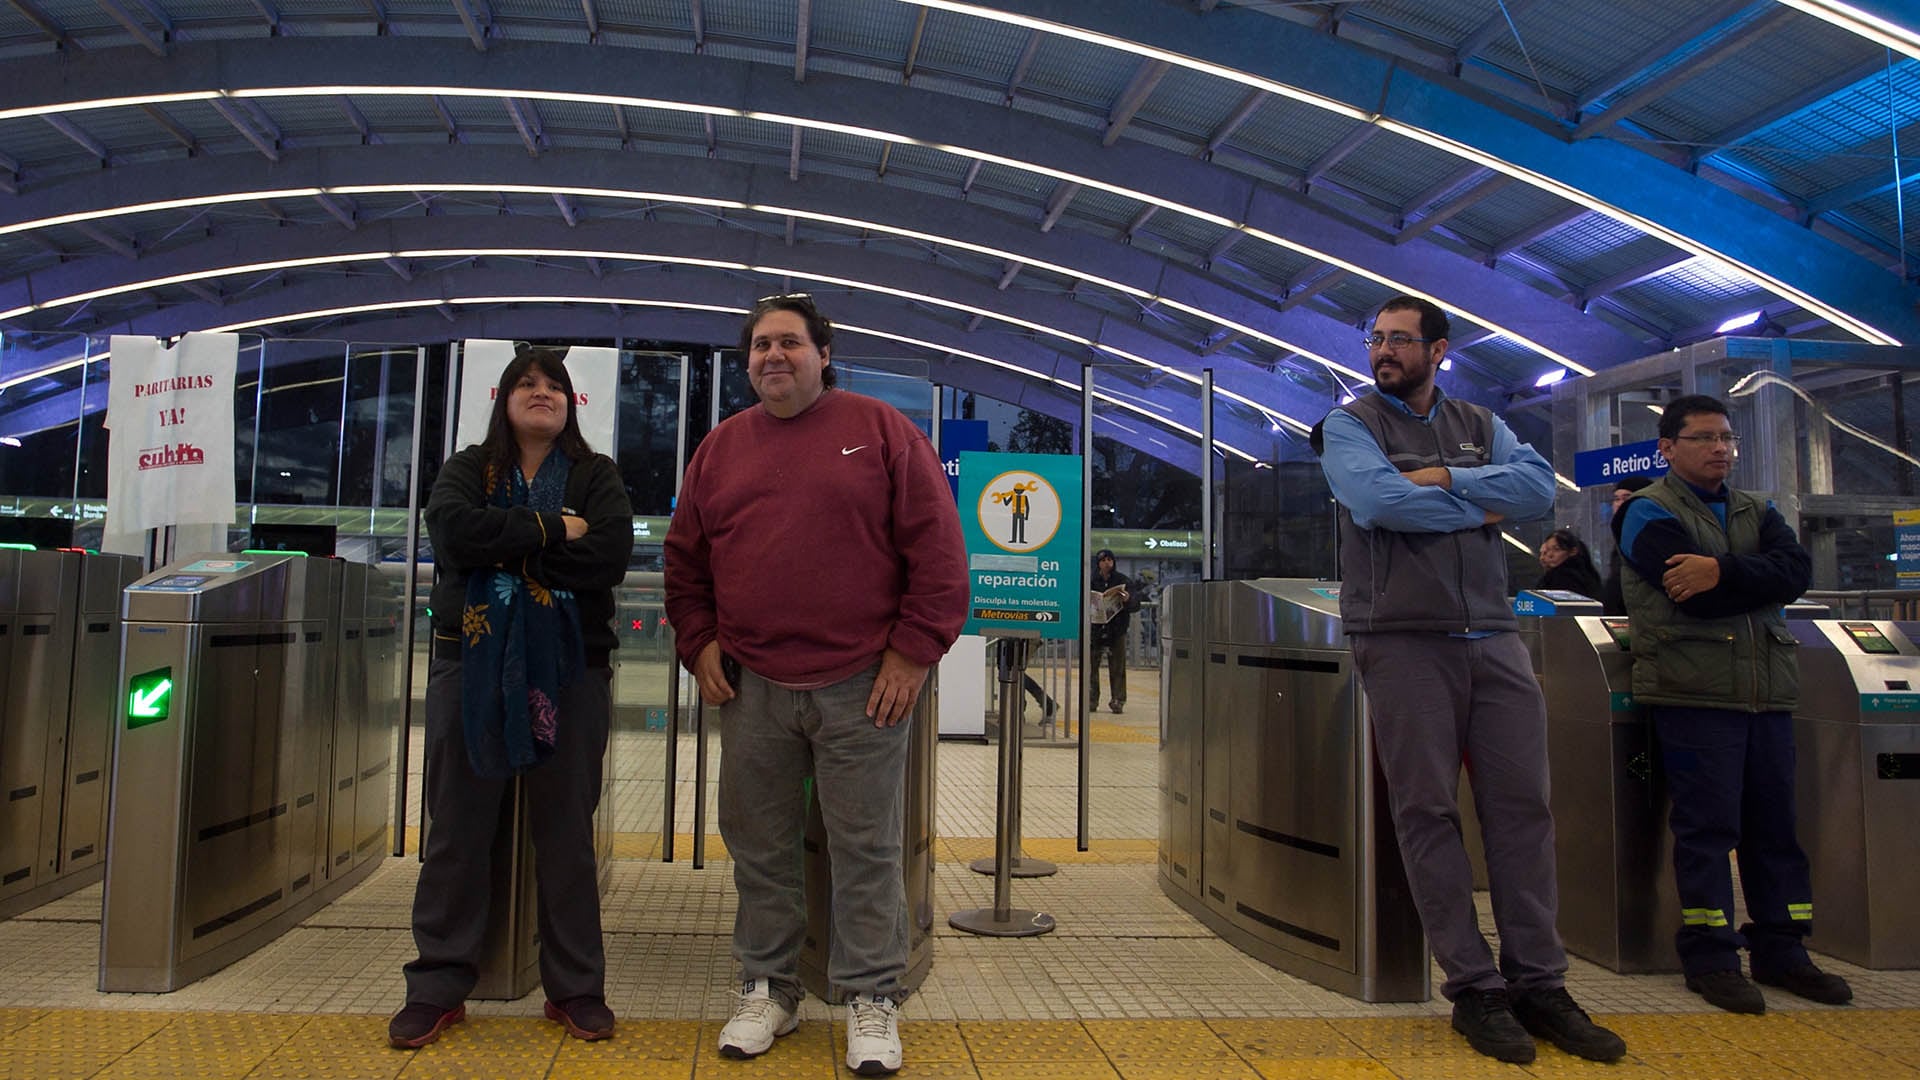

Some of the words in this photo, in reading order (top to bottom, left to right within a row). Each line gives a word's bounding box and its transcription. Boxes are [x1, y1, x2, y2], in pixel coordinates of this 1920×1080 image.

[135, 375, 213, 397] PARITARIAS
[159, 407, 185, 427] YA!
[1602, 463, 1610, 476] a
[1613, 453, 1651, 475] Retiro
[1041, 560, 1059, 571] en
[978, 574, 1057, 588] reparación
[1008, 597, 1019, 605] las
[1516, 600, 1534, 612] SUBE
